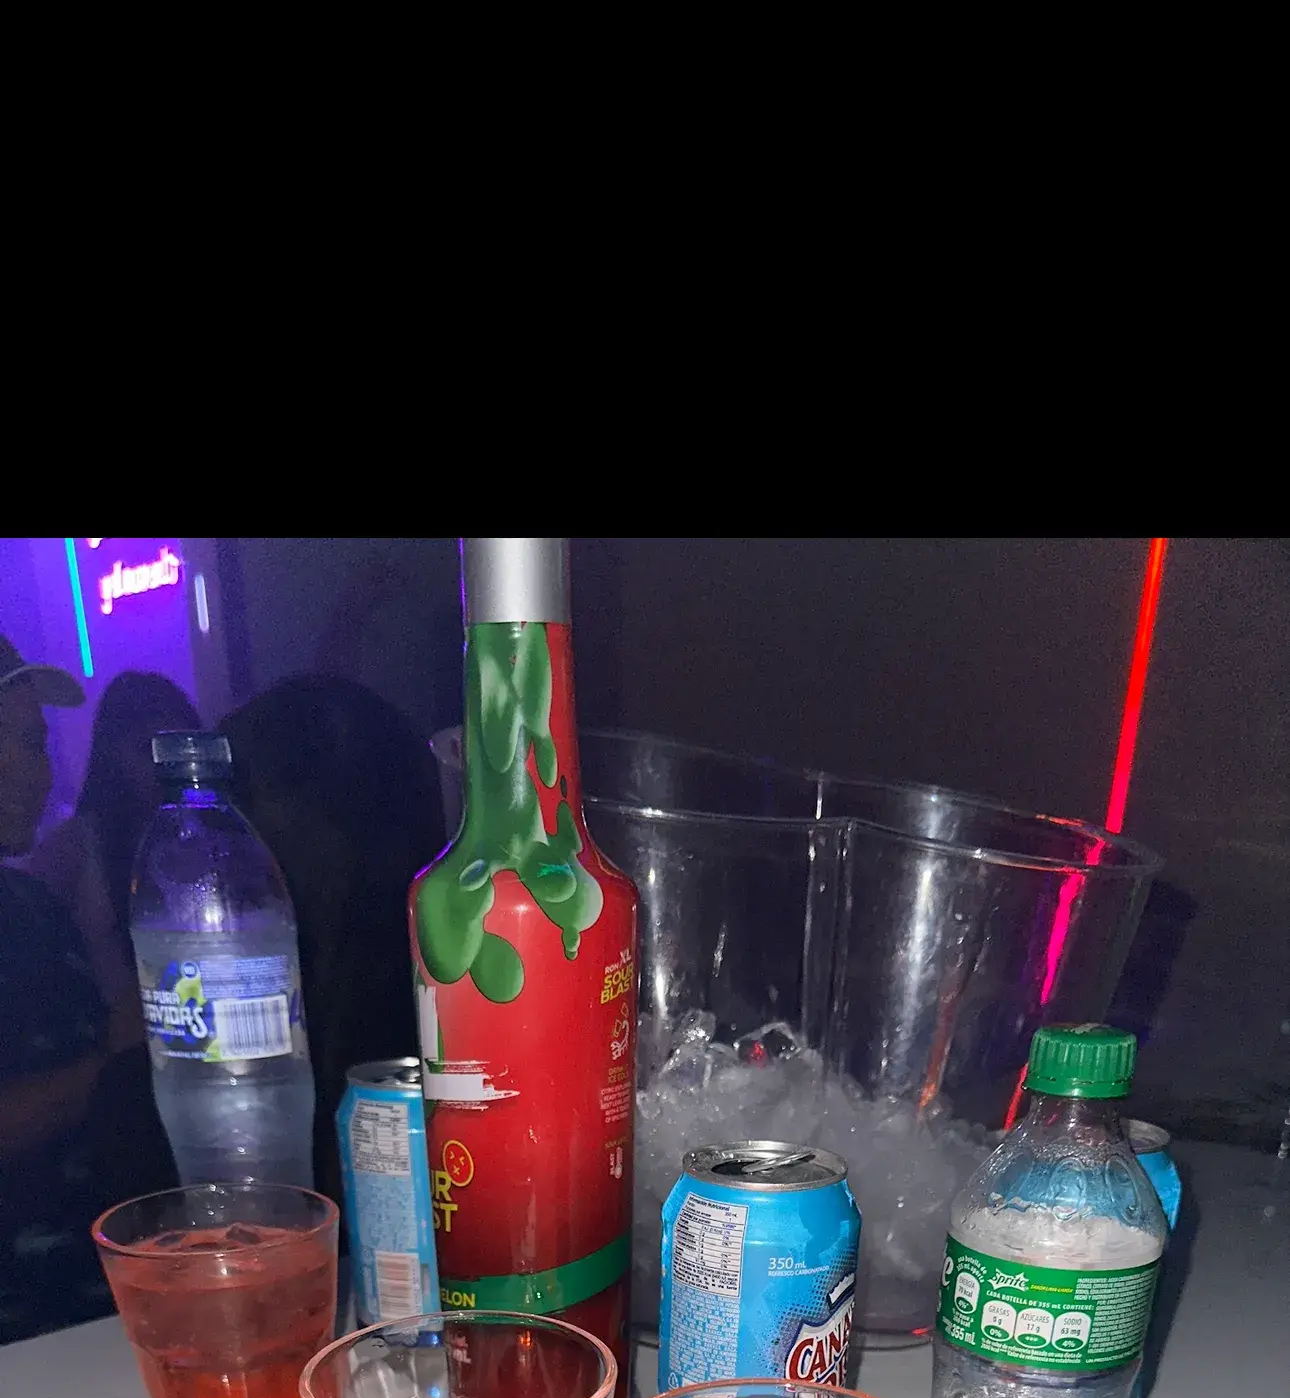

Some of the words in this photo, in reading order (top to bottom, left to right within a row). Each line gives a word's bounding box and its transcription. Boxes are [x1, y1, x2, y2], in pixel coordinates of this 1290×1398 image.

[605, 964, 619, 975] RON
[620, 948, 632, 964] XL
[603, 961, 635, 990] SOUR
[768, 1257, 794, 1270] 350
[964, 1255, 981, 1269] botella
[794, 1265, 830, 1276] CARBONATADO
[990, 1270, 1026, 1289] Sprite
[986, 1290, 1001, 1299] CADA
[1001, 1294, 1027, 1306] BOTELLA
[988, 1305, 1010, 1317] GRASAS
[997, 1318, 1002, 1326] g
[1063, 1317, 1082, 1326] SODIO
[951, 1323, 965, 1341] 355
[964, 1331, 976, 1346] mL
[989, 1328, 1002, 1338] 0%
[1026, 1323, 1035, 1331] 17
[1036, 1326, 1041, 1334] g
[1060, 1327, 1069, 1335] 63
[1069, 1328, 1081, 1336] mg
[1061, 1340, 1076, 1348] 4%
